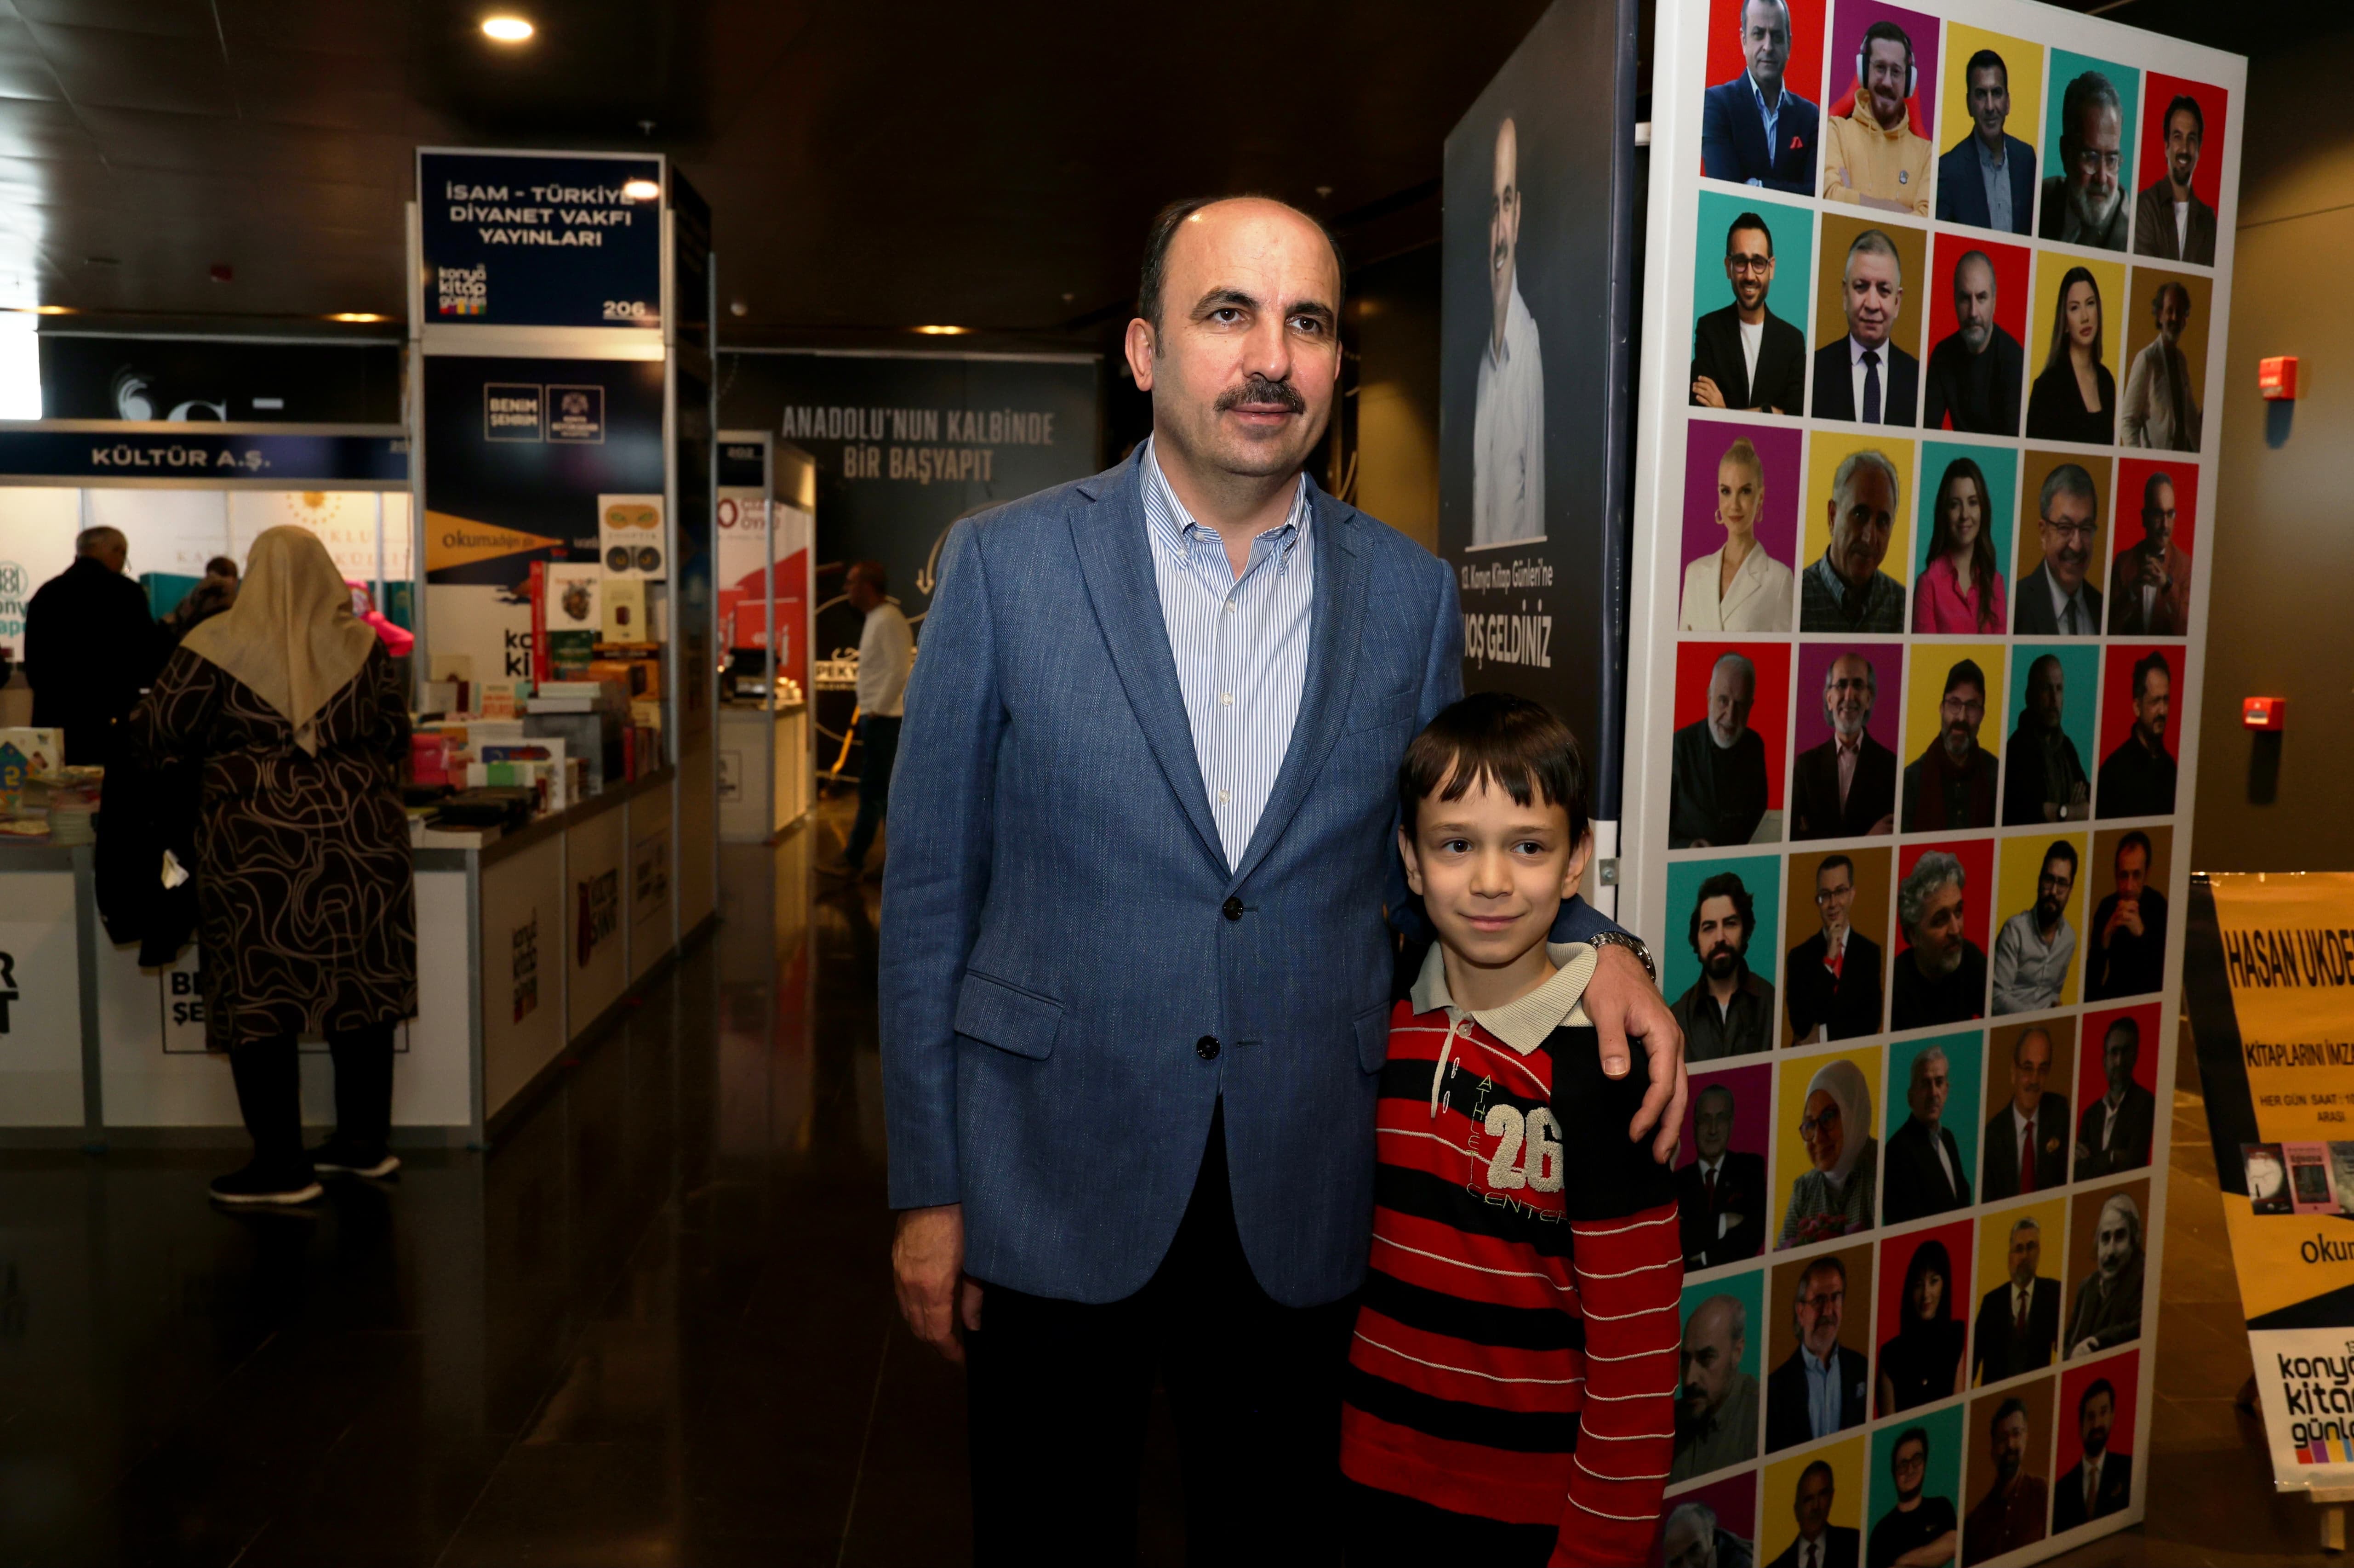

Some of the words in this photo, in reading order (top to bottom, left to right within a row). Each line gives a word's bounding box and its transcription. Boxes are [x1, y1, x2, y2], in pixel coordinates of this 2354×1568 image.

[446, 181, 508, 201] İSAM
[531, 183, 635, 205] TÜRKİYE
[450, 205, 554, 224] DİYANET
[560, 209, 632, 226] VAKFI
[479, 227, 602, 246] YAYINLARI
[603, 300, 645, 316] 206
[783, 406, 939, 441] ANADOLU'NUN
[947, 409, 1055, 445] KALBİNDE
[92, 445, 208, 467] KÜLTÜR
[217, 450, 270, 471] A.Ş.
[844, 446, 880, 479] BİR
[889, 448, 993, 485] BAŞYAPIT
[1487, 599, 1552, 668] GELDİNİZ
[2225, 929, 2301, 988] HASAN
[2297, 929, 2354, 987] UKDE
[2245, 1040, 2325, 1067] KİTAPLARINI
[1485, 1104, 1566, 1193] 26
[2284, 1382, 2354, 1415] kita
